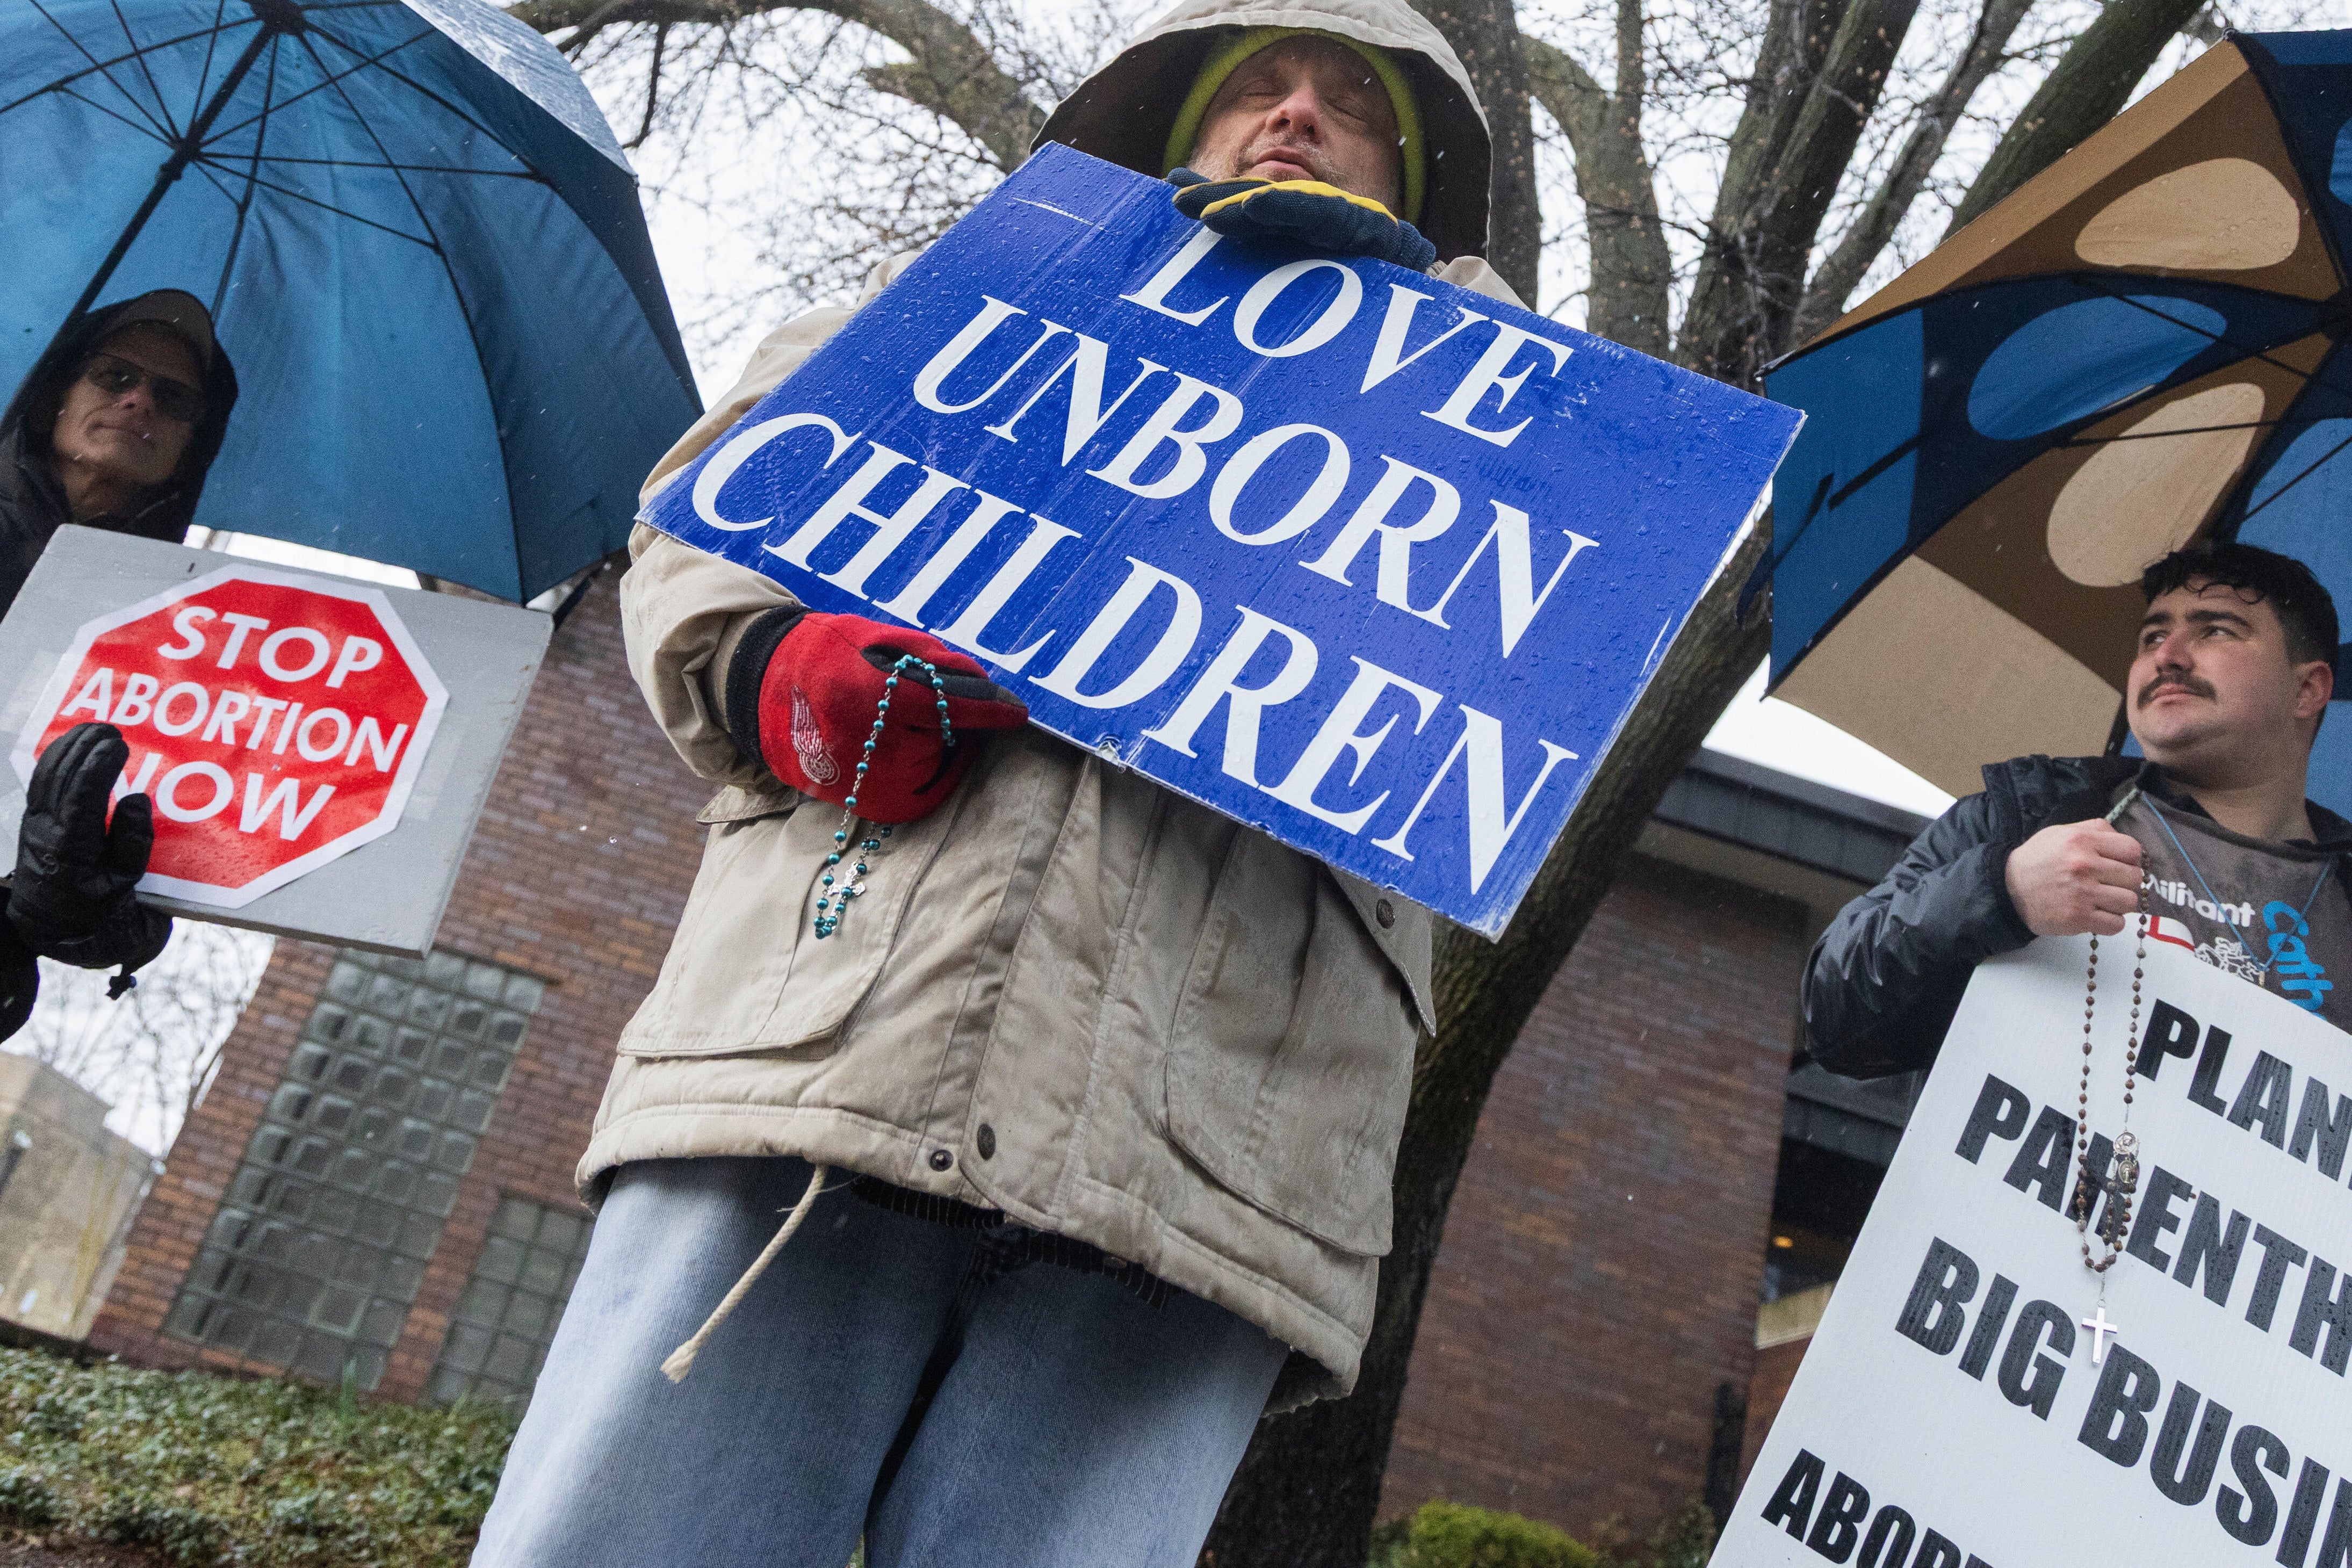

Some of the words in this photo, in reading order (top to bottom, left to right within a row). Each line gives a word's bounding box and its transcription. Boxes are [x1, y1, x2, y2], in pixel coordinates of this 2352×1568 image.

[1119, 226, 1574, 447] LOVE
[914, 295, 1600, 658] UNBORN
[60, 667, 407, 772] ABORTION
[158, 606, 382, 688] STOP
[692, 413, 1578, 895] CHILDREN
[2263, 901, 2333, 1021] Cath
[2135, 998, 2352, 1190] PLAN
[1955, 1073, 2352, 1381] PARENTH
[1894, 1236, 2076, 1421] BIG
